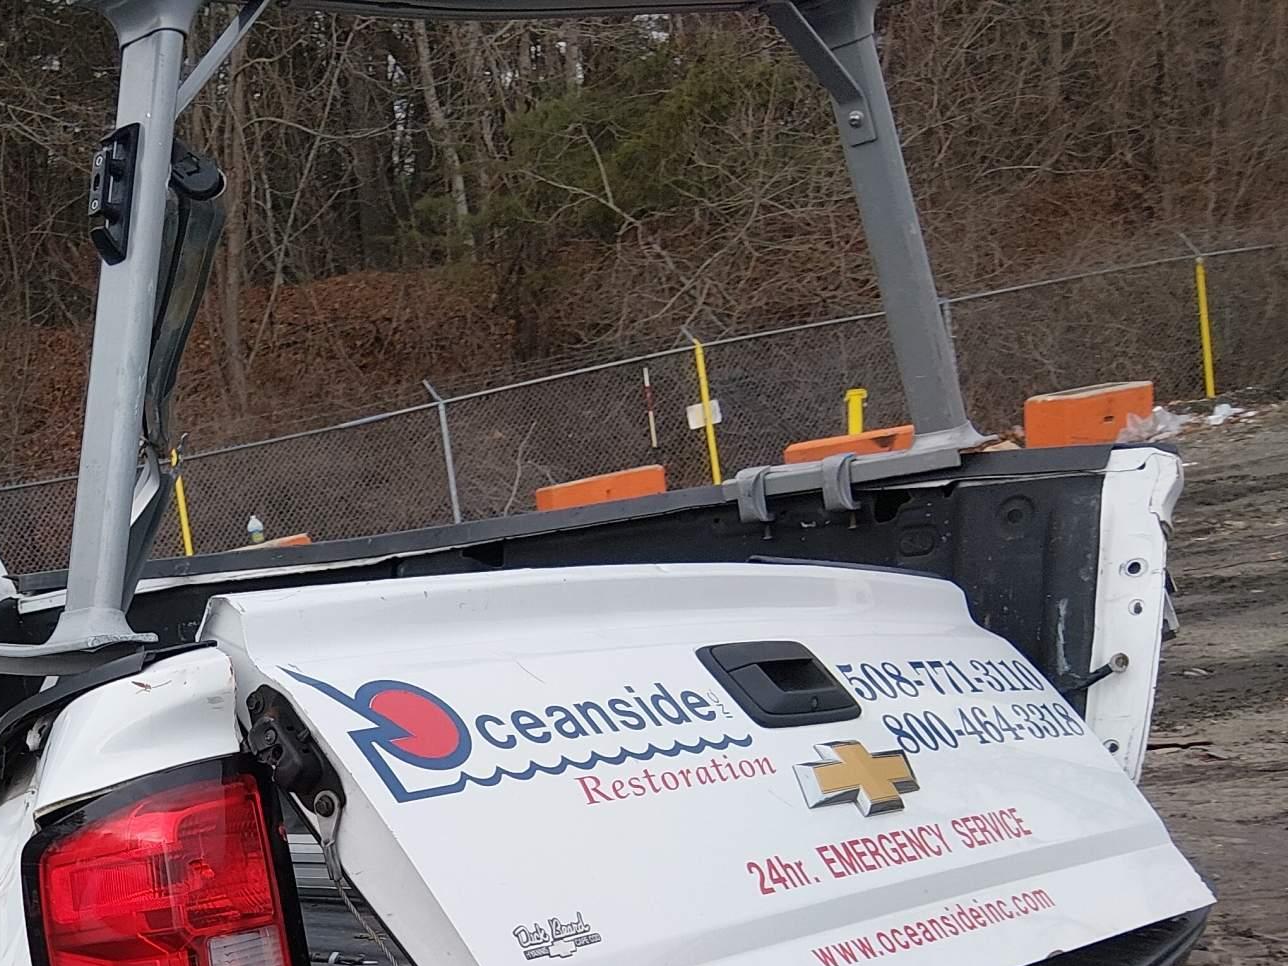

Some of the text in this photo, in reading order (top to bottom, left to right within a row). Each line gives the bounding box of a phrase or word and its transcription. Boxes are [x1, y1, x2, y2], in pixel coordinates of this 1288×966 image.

[836, 659, 1045, 702] 508-771-3110
[882, 703, 1085, 754] 800-464-3318
[577, 754, 777, 805] Restoration
[746, 807, 1032, 896] 24hr. EMERGENCY SERVICE
